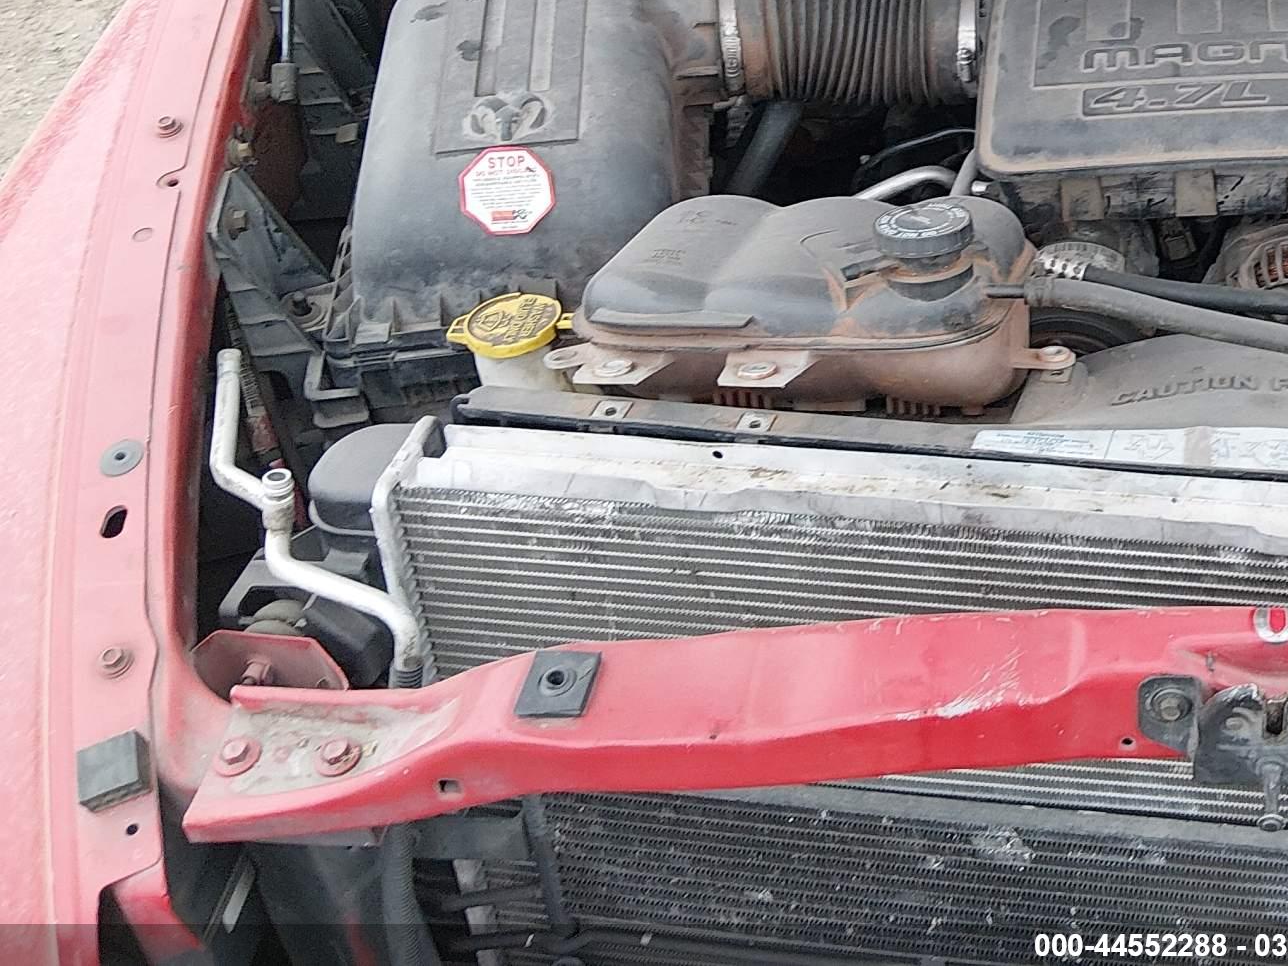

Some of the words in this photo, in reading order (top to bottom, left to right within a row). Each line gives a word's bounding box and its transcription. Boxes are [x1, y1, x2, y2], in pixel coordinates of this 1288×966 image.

[1090, 81, 1268, 109] 4.7L
[488, 155, 525, 168] STOP
[1110, 375, 1259, 406] CAUTION
